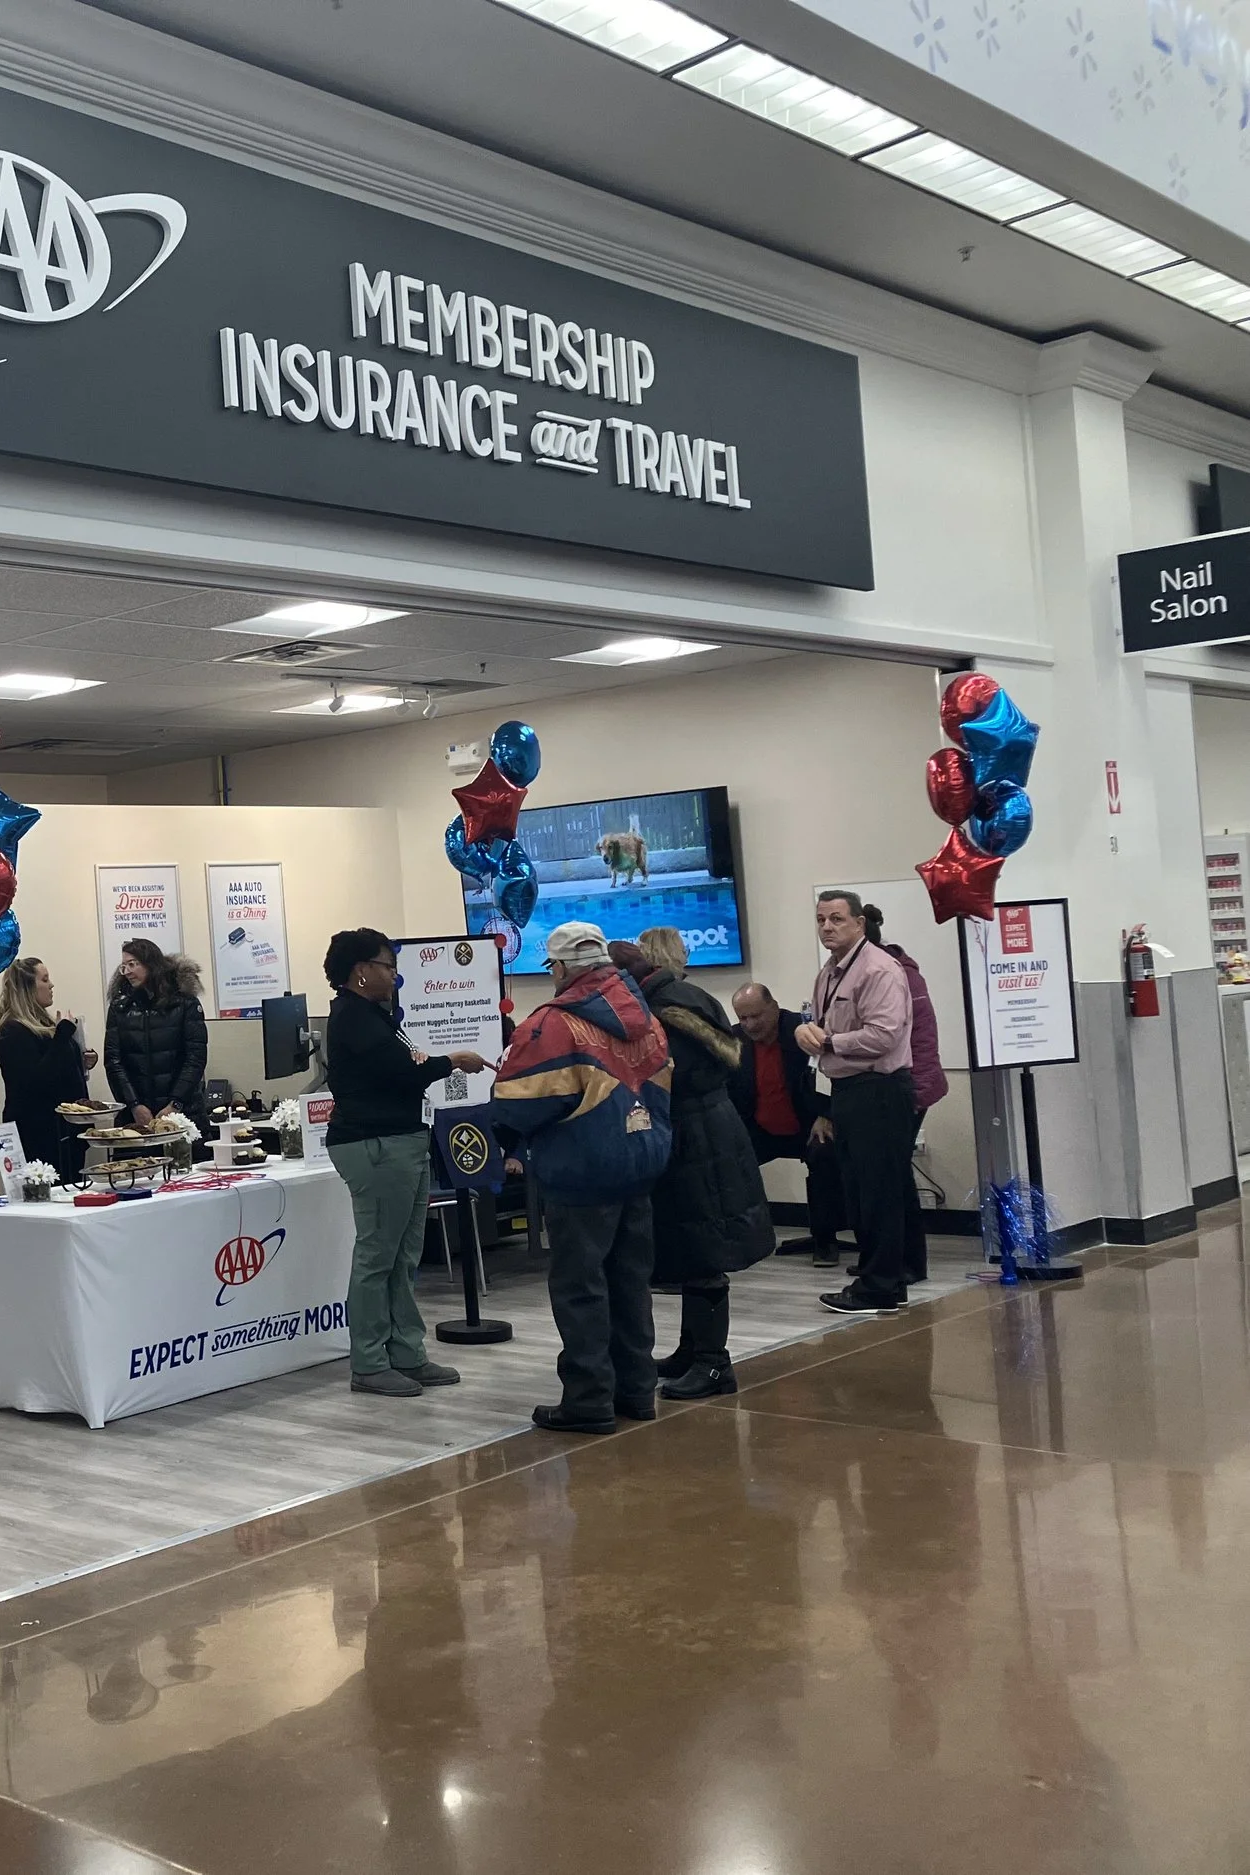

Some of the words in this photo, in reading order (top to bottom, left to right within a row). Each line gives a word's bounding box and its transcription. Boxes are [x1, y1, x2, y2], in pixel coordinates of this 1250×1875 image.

[349, 262, 655, 405] MEMBERSHIP
[220, 327, 522, 464] INSURANCE
[531, 418, 601, 465] and
[606, 417, 751, 509] TRAVEL
[1160, 561, 1213, 593] Nail
[1150, 594, 1228, 623] Salon
[228, 882, 243, 892] AAA
[244, 882, 262, 892] AUTO
[115, 892, 164, 910] Drivers
[225, 895, 266, 905] INSURANCE
[243, 906, 267, 920] Thing
[1006, 938, 1029, 948] MORE
[990, 963, 1016, 975] COME
[1018, 962, 1028, 972] IN
[1030, 961, 1049, 971] AND
[424, 980, 448, 995] Enter
[449, 980, 458, 992] to
[459, 979, 475, 989] win
[998, 974, 1023, 989] visit
[410, 1003, 429, 1012] Signed
[429, 1001, 445, 1010] Jamal
[445, 1000, 464, 1009] Murray
[464, 998, 491, 1007] Basketball
[407, 1020, 426, 1028] Denver
[427, 1018, 449, 1027] Nuggets
[449, 1017, 467, 1025] Center
[481, 1014, 500, 1022] Tickets
[215, 1237, 265, 1286] AAA
[130, 1331, 209, 1380] EXPECT
[211, 1316, 301, 1353] something
